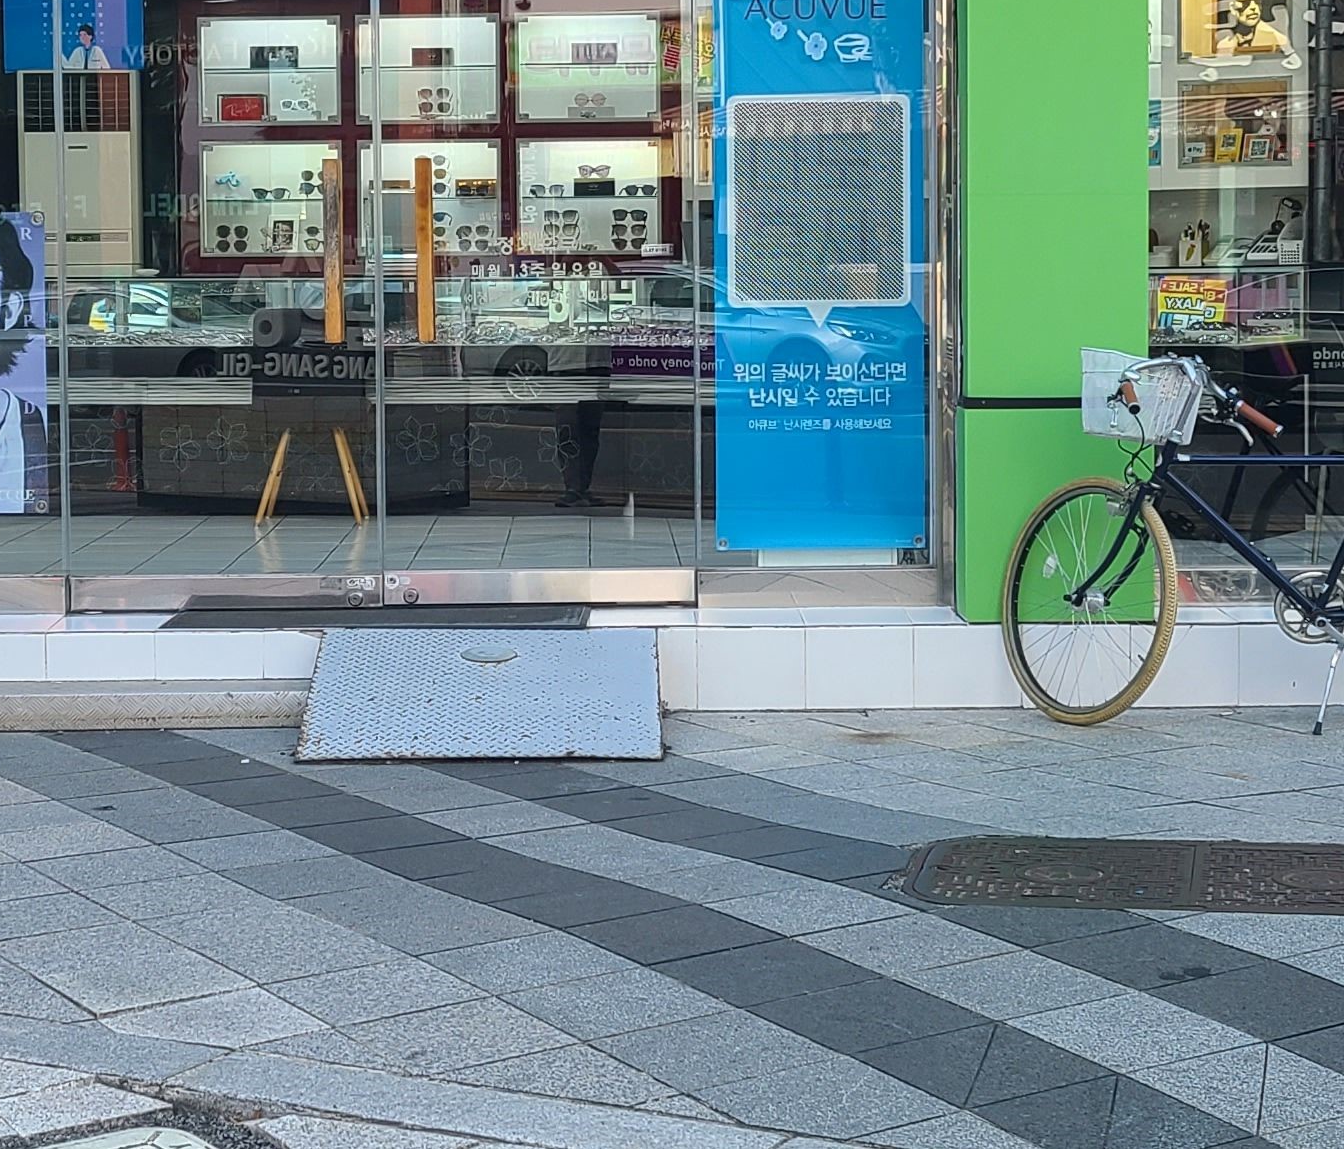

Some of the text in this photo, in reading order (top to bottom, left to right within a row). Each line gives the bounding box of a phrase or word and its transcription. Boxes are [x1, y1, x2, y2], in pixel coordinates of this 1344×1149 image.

[733, 362, 765, 382] 위의
[771, 362, 820, 382] 글씨가
[749, 387, 891, 408] 난시일 수 있습니다
